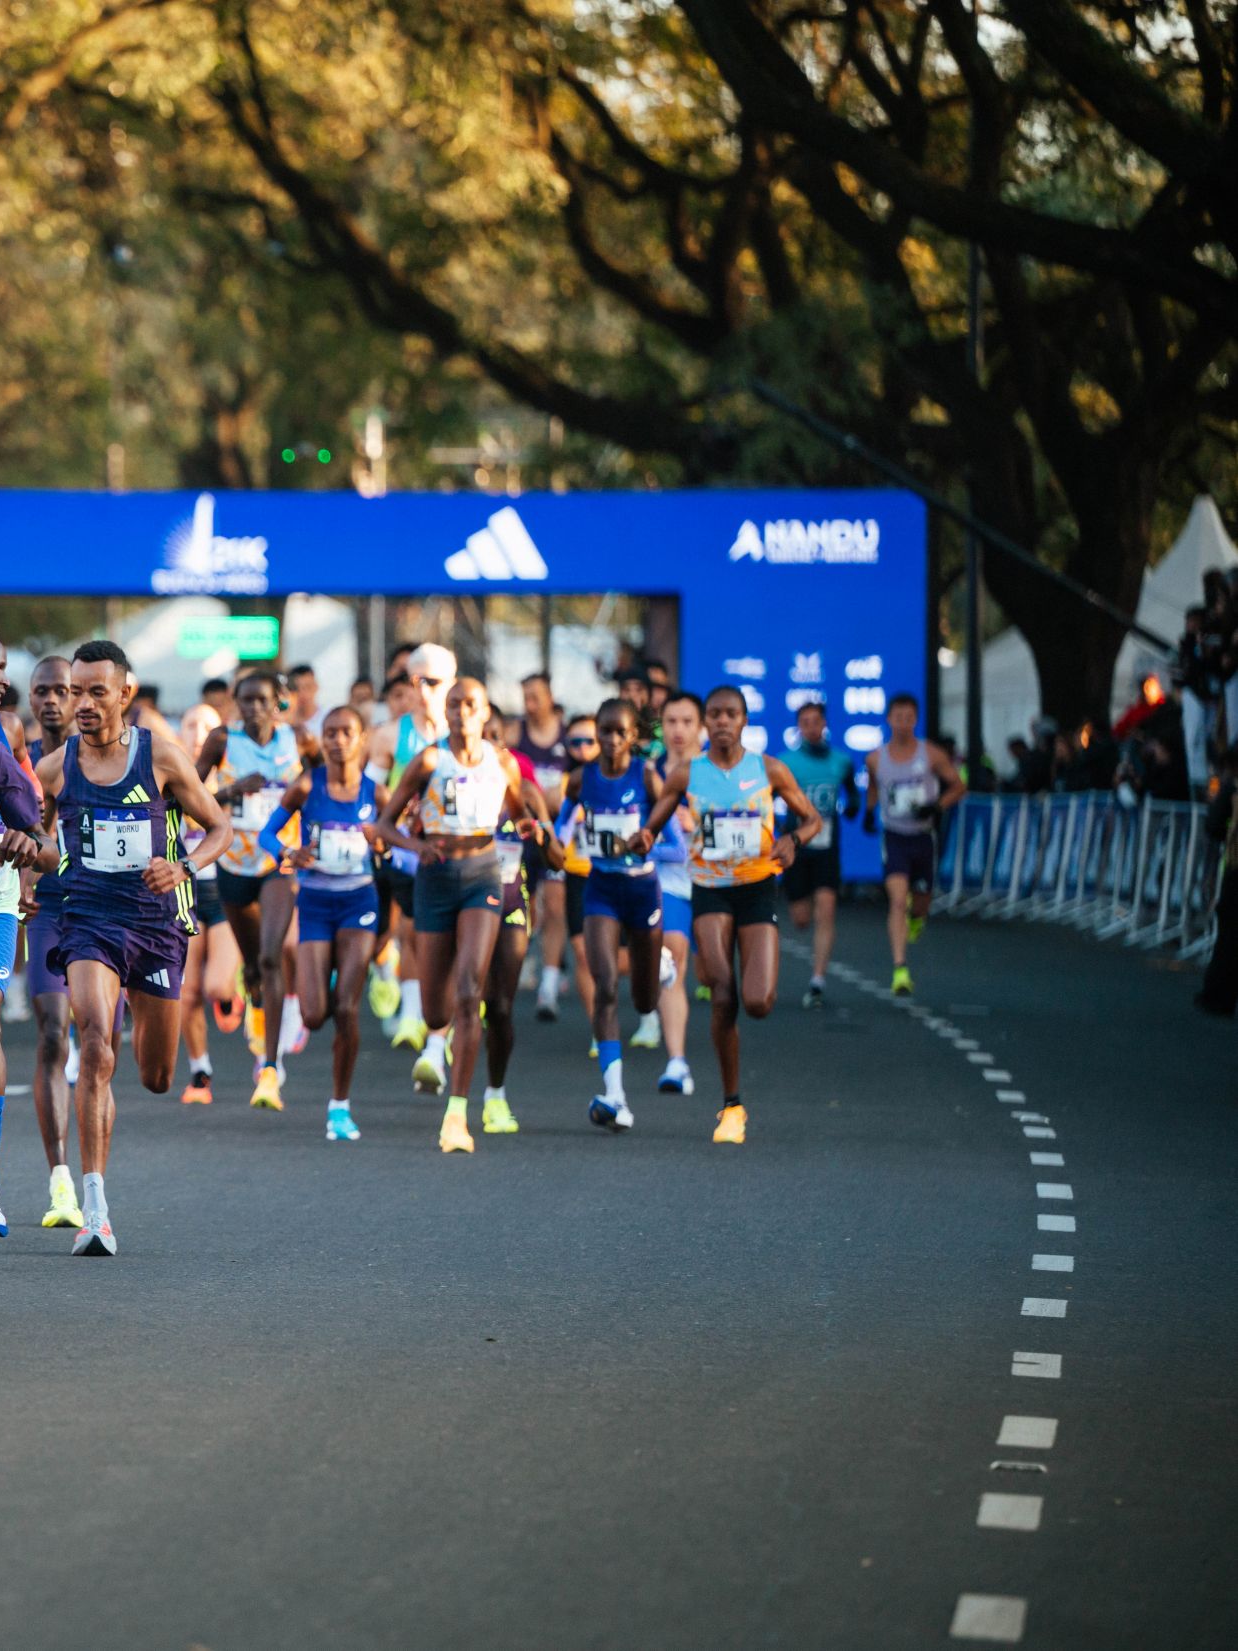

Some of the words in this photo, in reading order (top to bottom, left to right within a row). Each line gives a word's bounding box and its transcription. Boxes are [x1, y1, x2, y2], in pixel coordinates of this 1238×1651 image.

[82, 813, 90, 827] A
[116, 825, 140, 834] WORKU
[116, 839, 126, 857] 3
